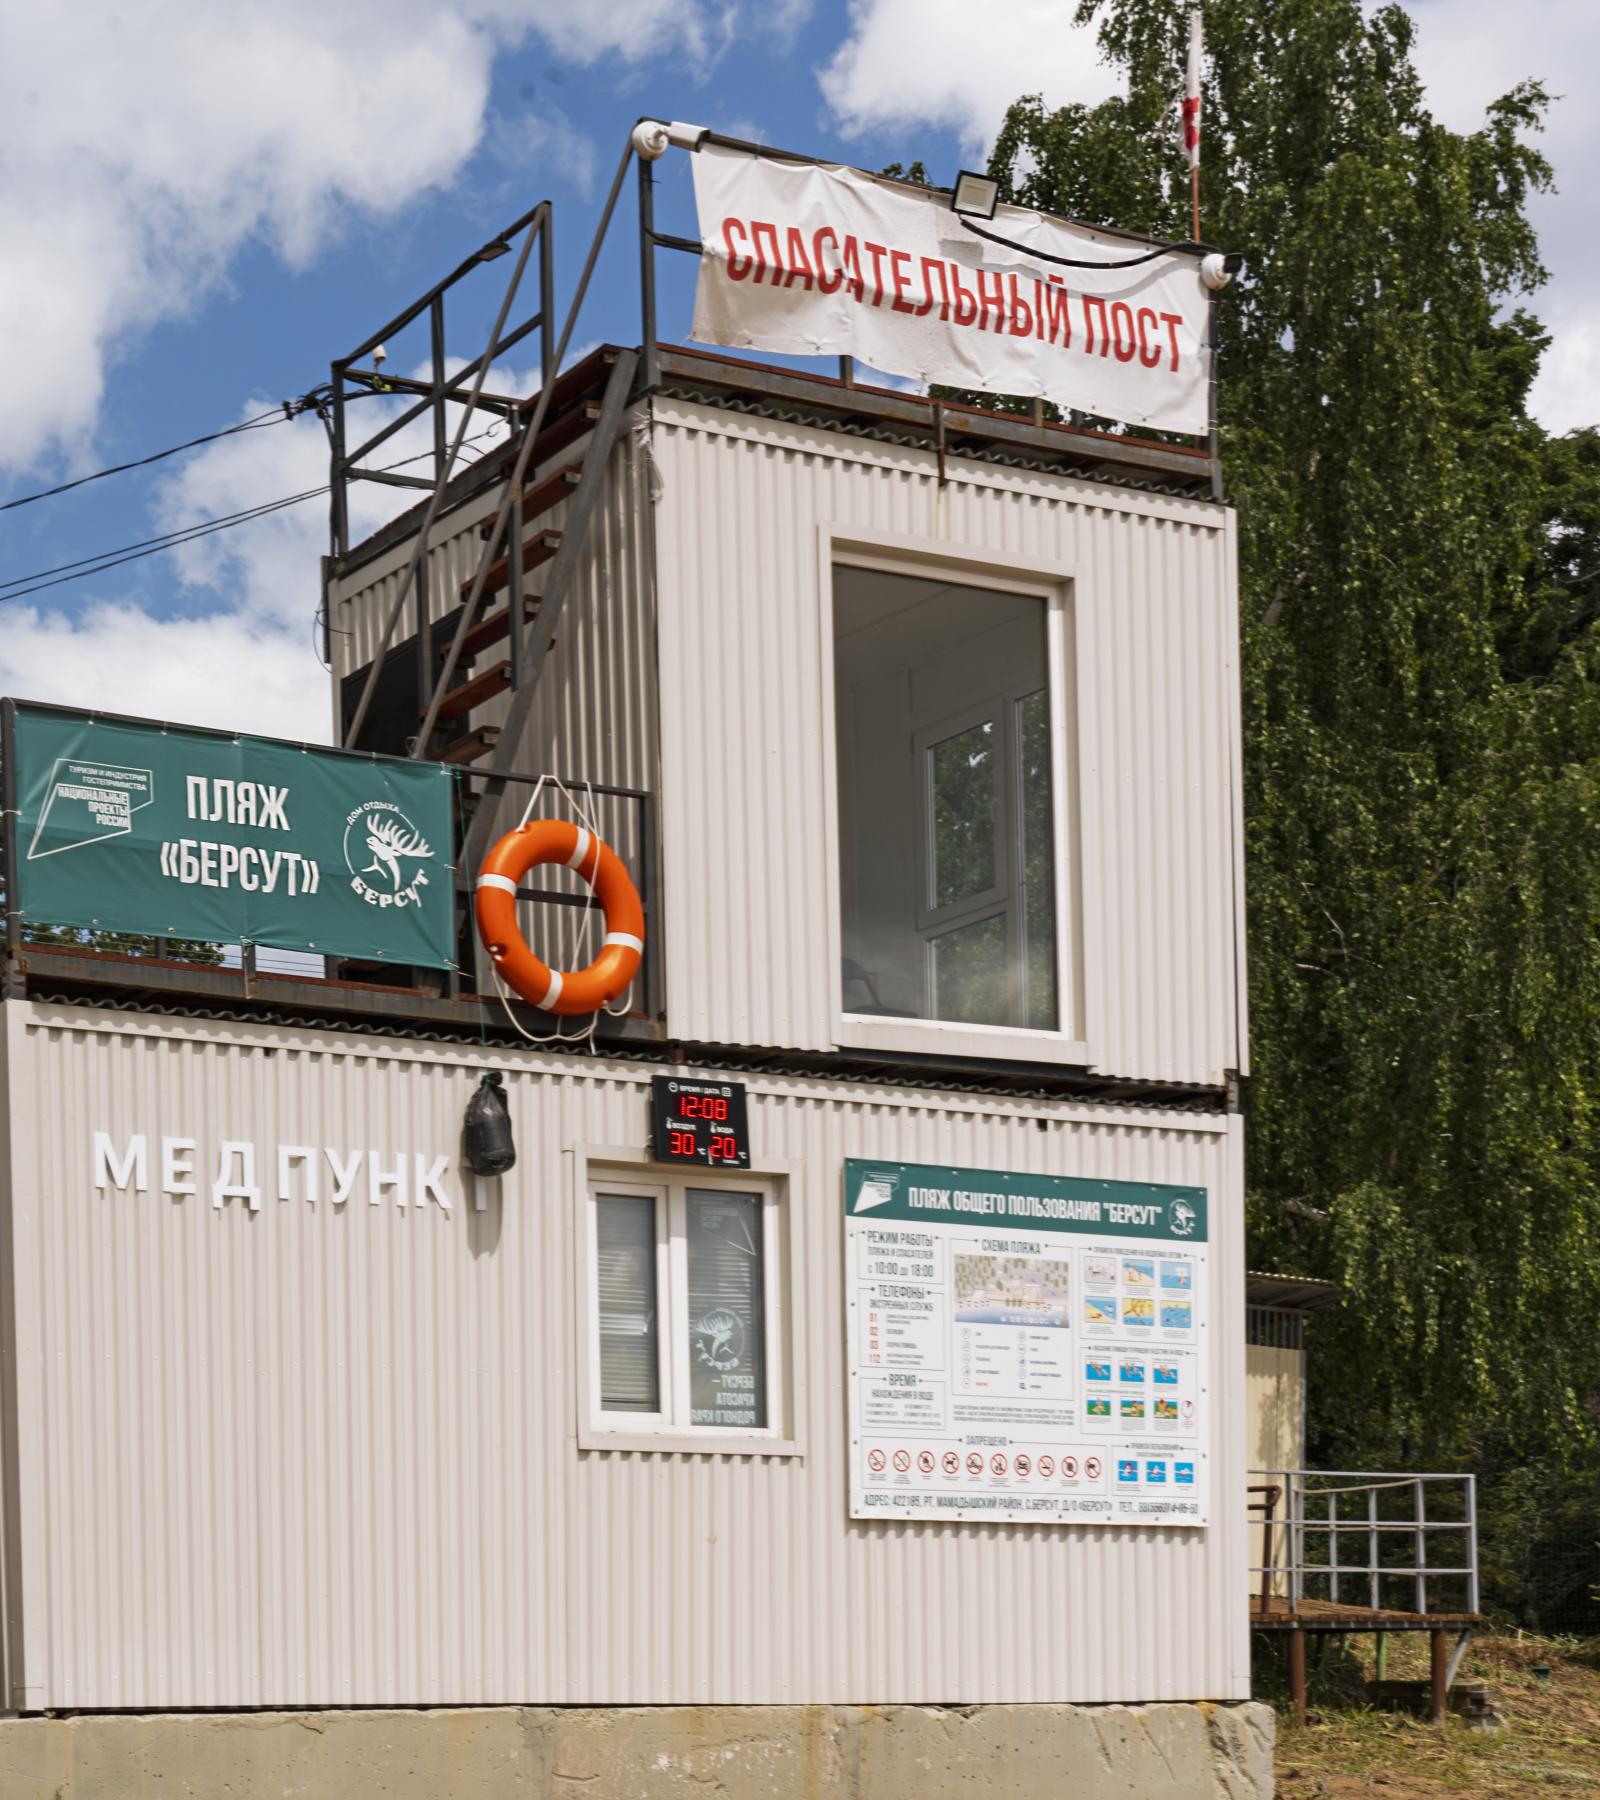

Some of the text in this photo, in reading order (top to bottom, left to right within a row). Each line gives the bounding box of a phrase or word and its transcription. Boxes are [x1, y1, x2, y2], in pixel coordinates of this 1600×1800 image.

[722, 217, 1183, 373] СПАСАТЕЛЬНЫЙ ПОСТ
[69, 765, 98, 776] ТУРИЗМ
[106, 770, 147, 782] ИНДУСТРИЯ
[58, 786, 128, 806] НАЦИОНАЛЬНЫЕ
[185, 775, 291, 832] ПЛЯЖ
[88, 801, 128, 817] ПРОЕКТЫ
[346, 801, 401, 826] ДОМ ОТДЫХА
[96, 813, 128, 828] РОССИИ
[160, 838, 320, 896] «БЕРСУТ»
[350, 868, 430, 909] БЕРСУТ
[681, 1096, 728, 1121] 12:08
[669, 1132, 696, 1155] 30
[709, 1136, 737, 1159] 20
[908, 1187, 1162, 1226] ПЛЯЖ ОБЩЕГО ПОЛЬЗОВАНИЯ "БЕРСУТ"
[867, 1230, 933, 1247] РЕЖИМ РАБОТЫ
[981, 1238, 1041, 1255] СХЕМА ПЛЯЖА
[875, 1261, 898, 1275] 10:00
[911, 1264, 934, 1277] 18:00
[878, 1284, 925, 1299] ТЕЛЕФОНЫ
[889, 1373, 916, 1386] ВРЕМЯ
[966, 1435, 1007, 1447] ЗАПРЕЩЕНО
